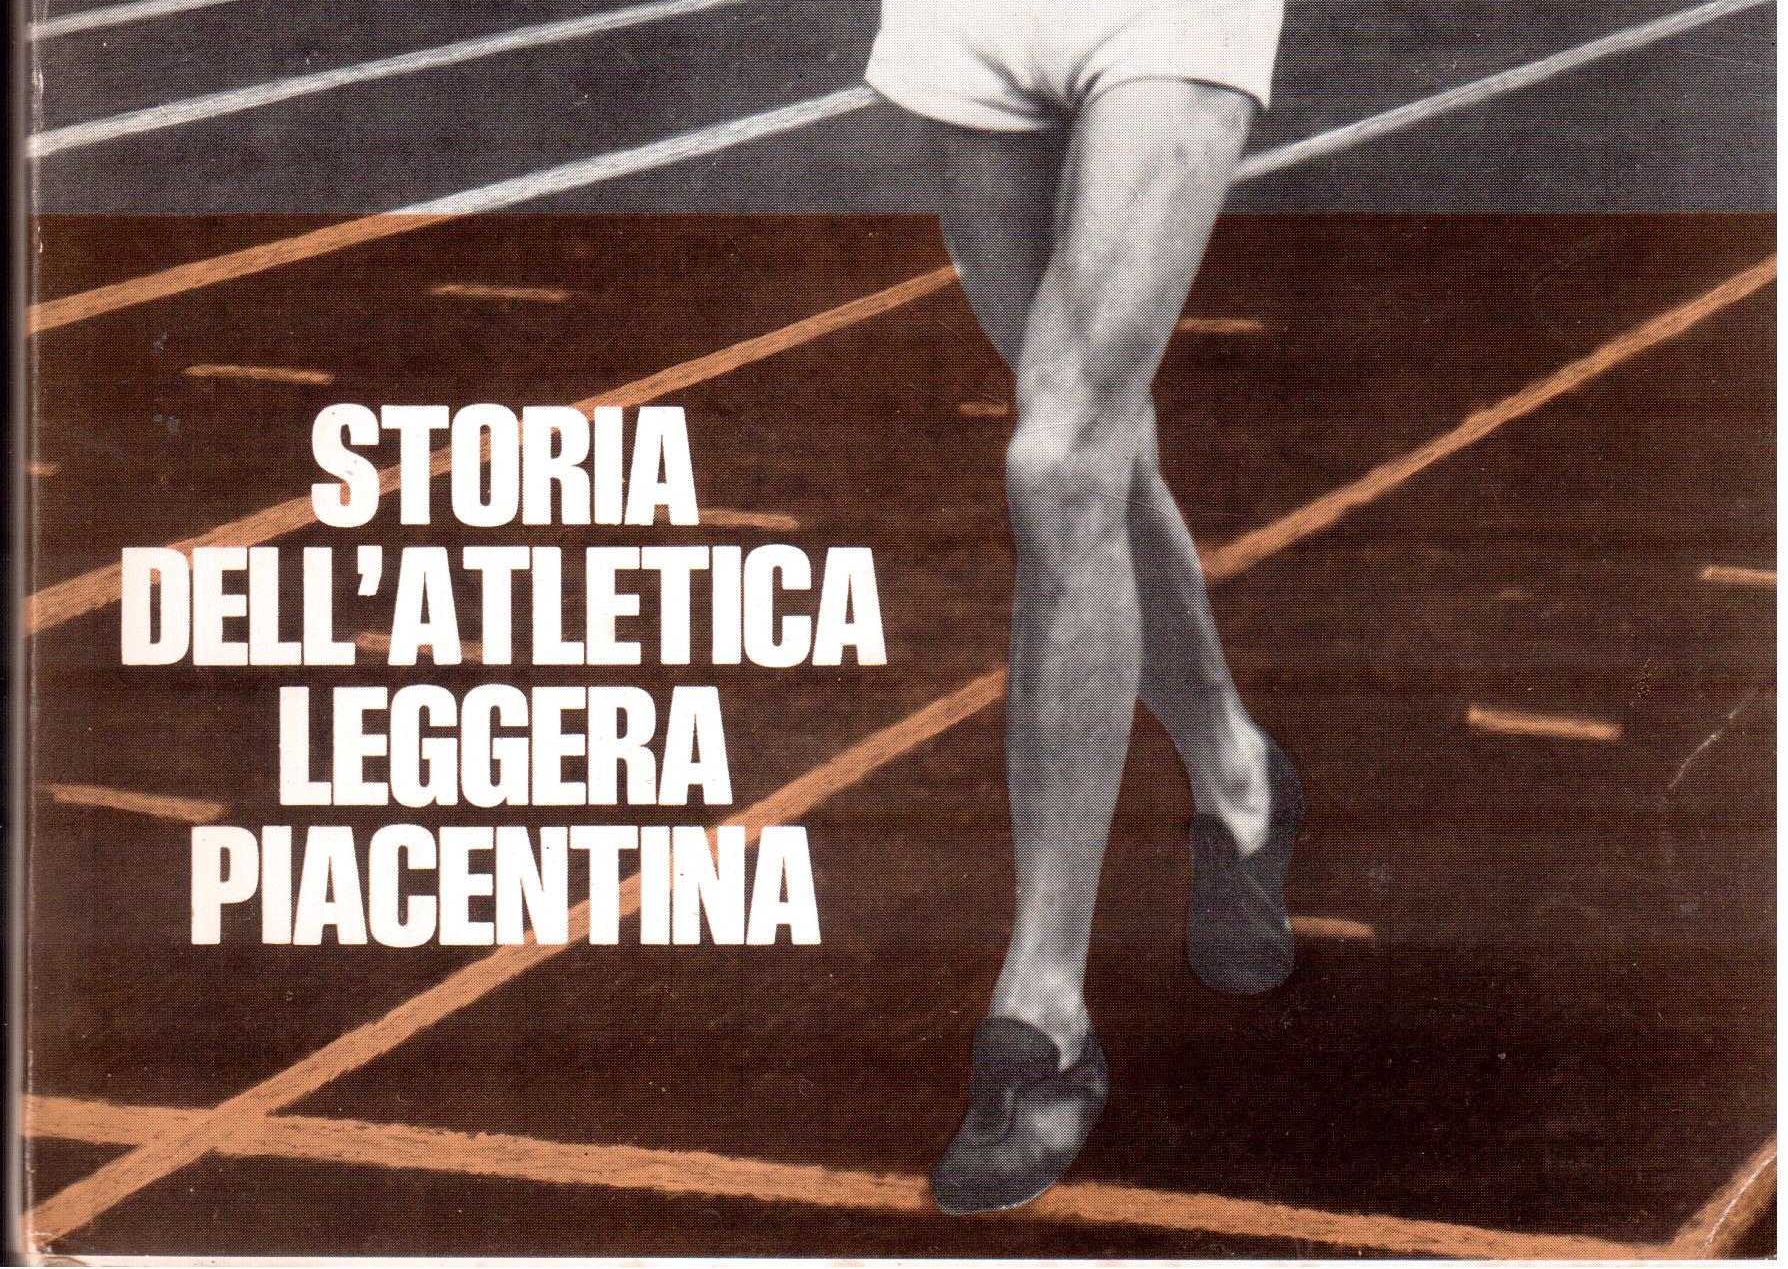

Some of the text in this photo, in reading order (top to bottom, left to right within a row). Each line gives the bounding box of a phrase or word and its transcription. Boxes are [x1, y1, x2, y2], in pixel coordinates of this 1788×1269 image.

[310, 403, 701, 528] STORIA
[279, 683, 733, 808] LEGGERA
[191, 823, 822, 948] PIACENTINA
